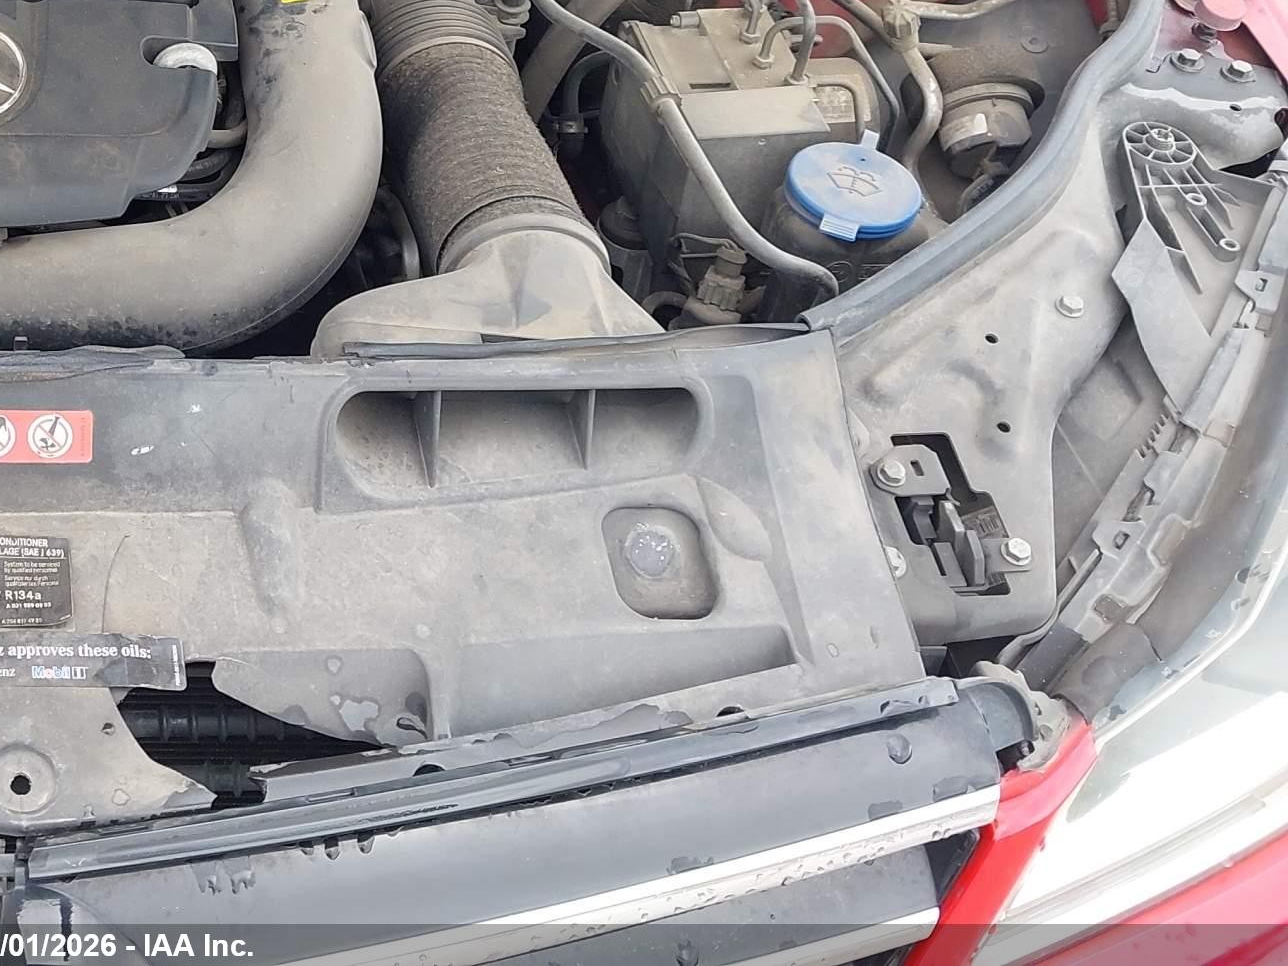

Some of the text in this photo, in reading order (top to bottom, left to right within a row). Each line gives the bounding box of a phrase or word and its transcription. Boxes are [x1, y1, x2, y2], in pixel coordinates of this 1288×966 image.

[46, 548, 65, 559] 639)
[4, 590, 42, 601] R134a
[8, 644, 75, 660] approves
[78, 643, 119, 657] these
[121, 644, 152, 659] oils:
[32, 665, 71, 680] Mobil
